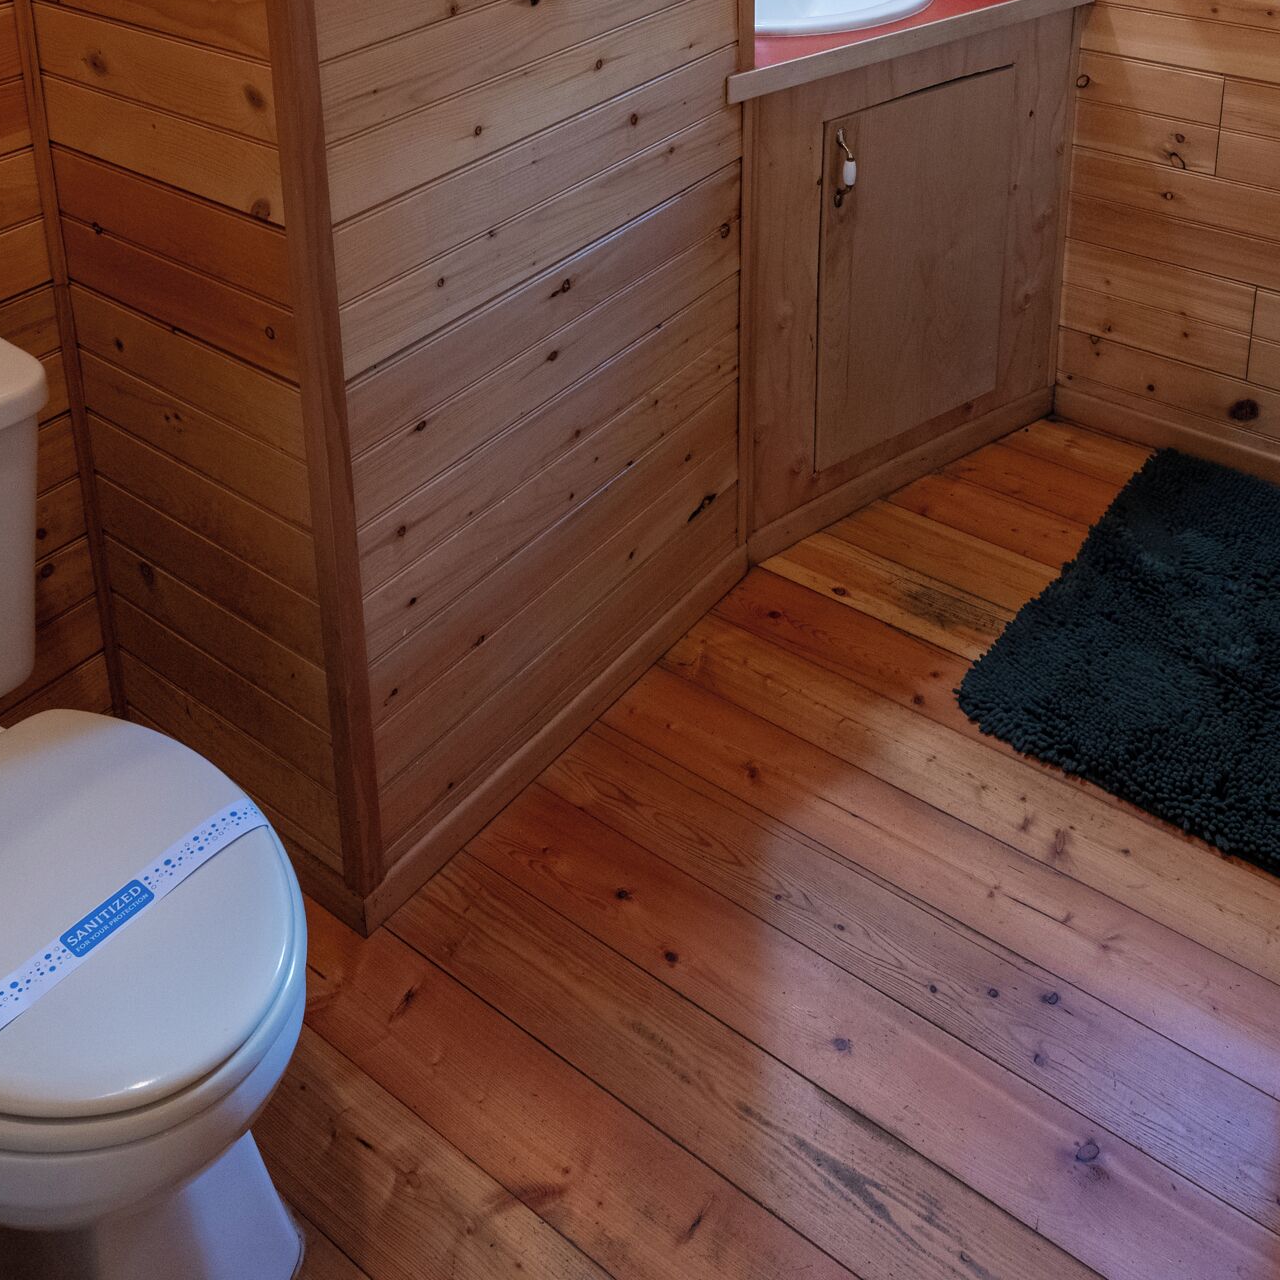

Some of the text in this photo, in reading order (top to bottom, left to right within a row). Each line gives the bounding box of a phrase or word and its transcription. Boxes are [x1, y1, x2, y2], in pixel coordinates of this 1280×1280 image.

[67, 886, 141, 946] SANITIZED
[75, 893, 149, 952] FOR YOUR PROTECTION
